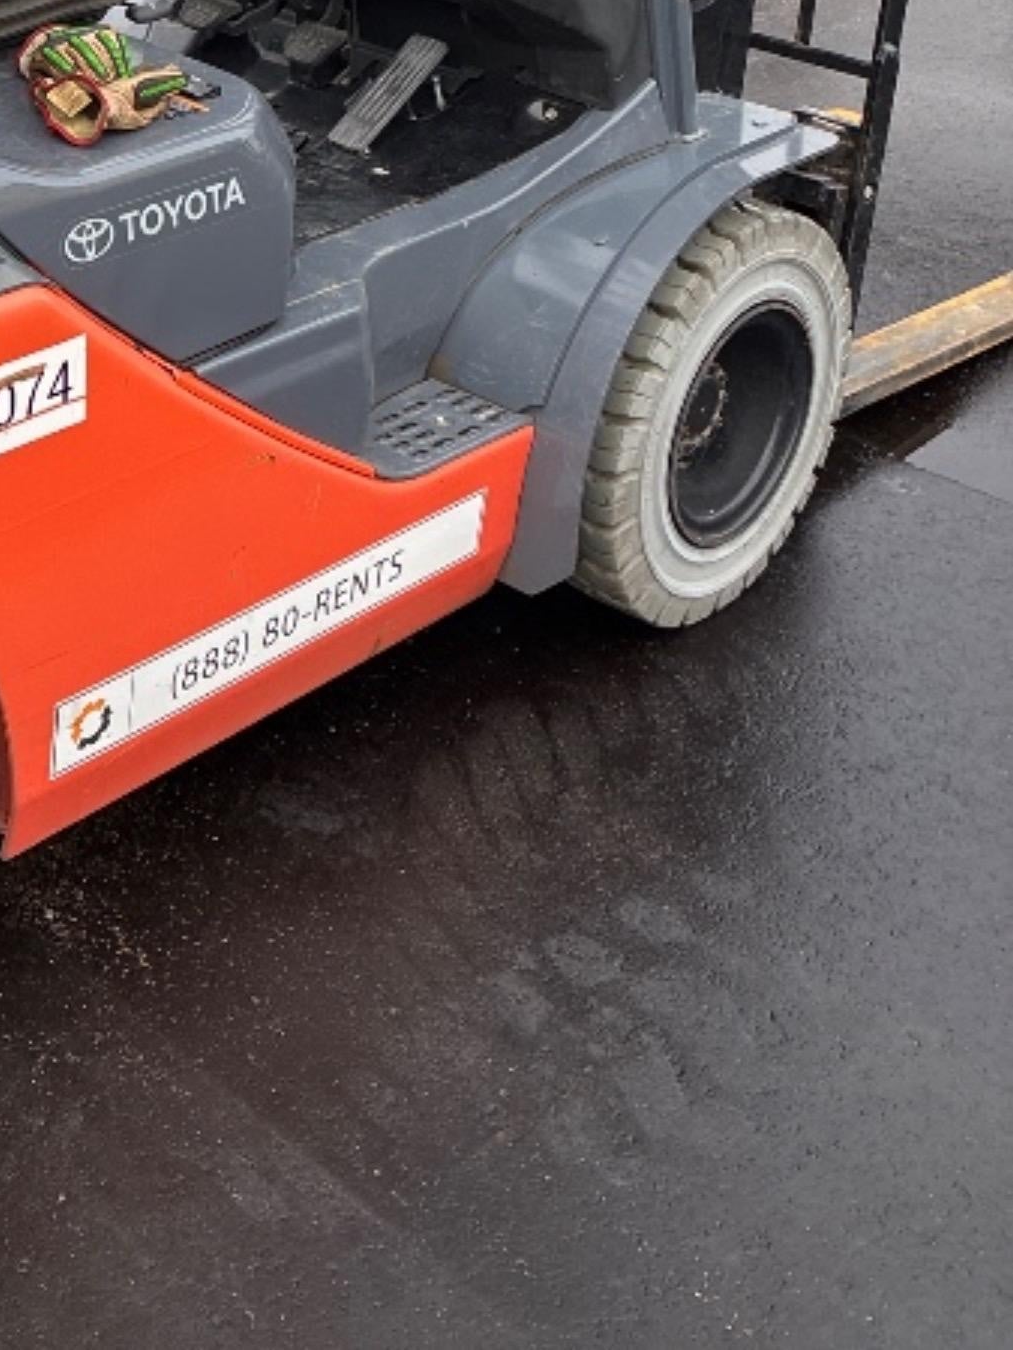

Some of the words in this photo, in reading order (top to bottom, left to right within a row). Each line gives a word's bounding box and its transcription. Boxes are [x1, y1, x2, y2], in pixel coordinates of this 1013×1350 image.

[119, 177, 246, 243] TOYOTA
[171, 631, 250, 700] (888)
[262, 549, 405, 650] 80-RENTS
